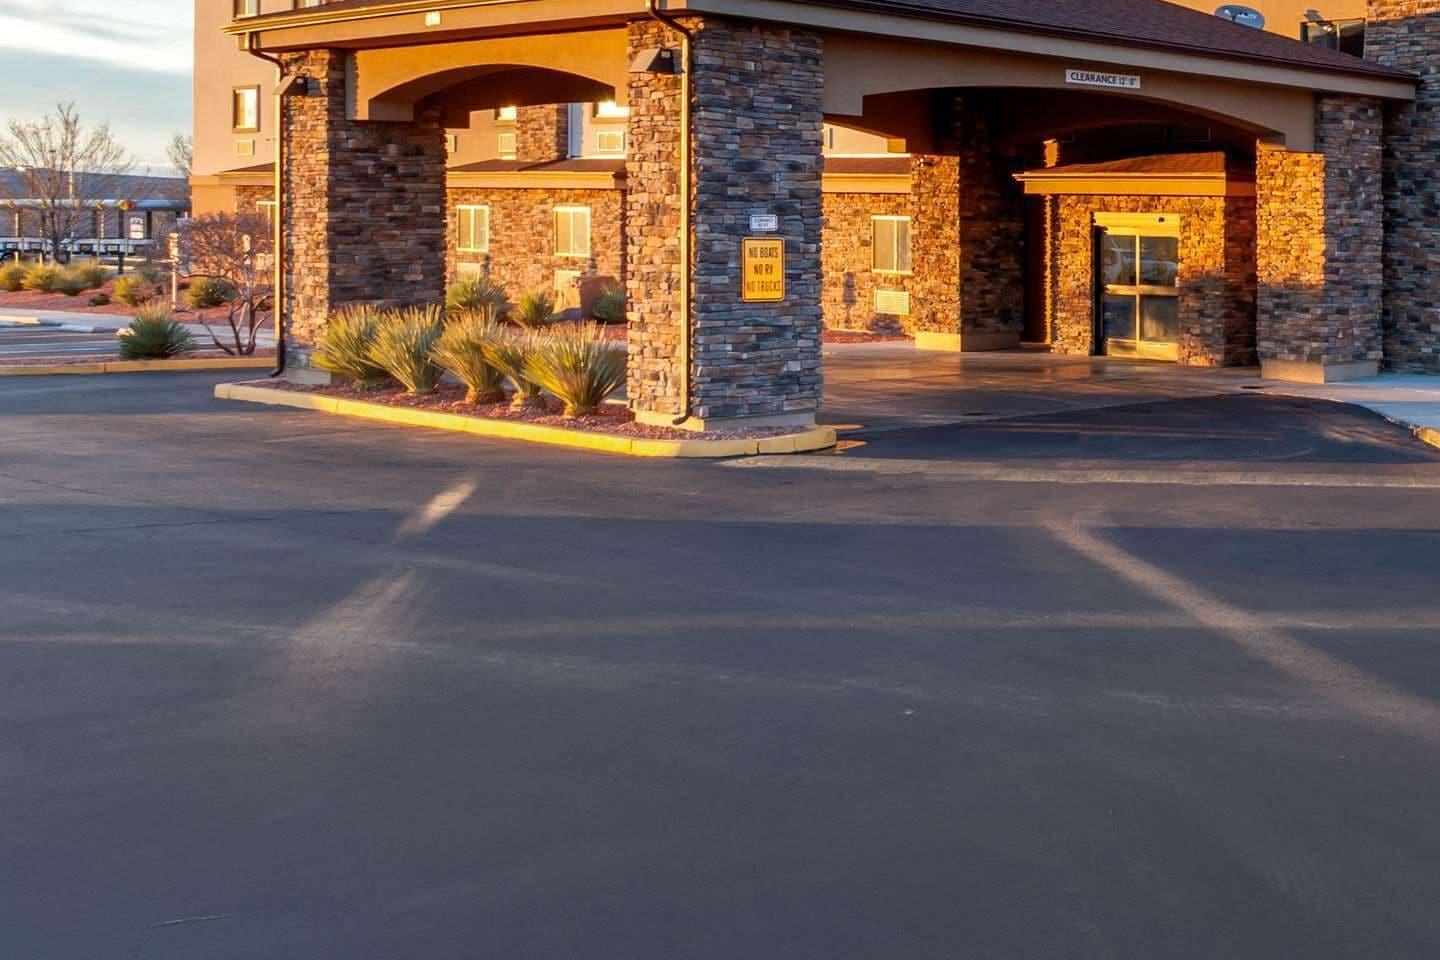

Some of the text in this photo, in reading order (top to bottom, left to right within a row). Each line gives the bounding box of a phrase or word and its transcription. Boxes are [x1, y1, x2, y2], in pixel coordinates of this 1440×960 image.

[1070, 71, 1117, 85] CLEARANCE
[749, 247, 758, 258] NO
[754, 263, 763, 275] NO
[747, 280, 781, 292] NO TRUCKS
